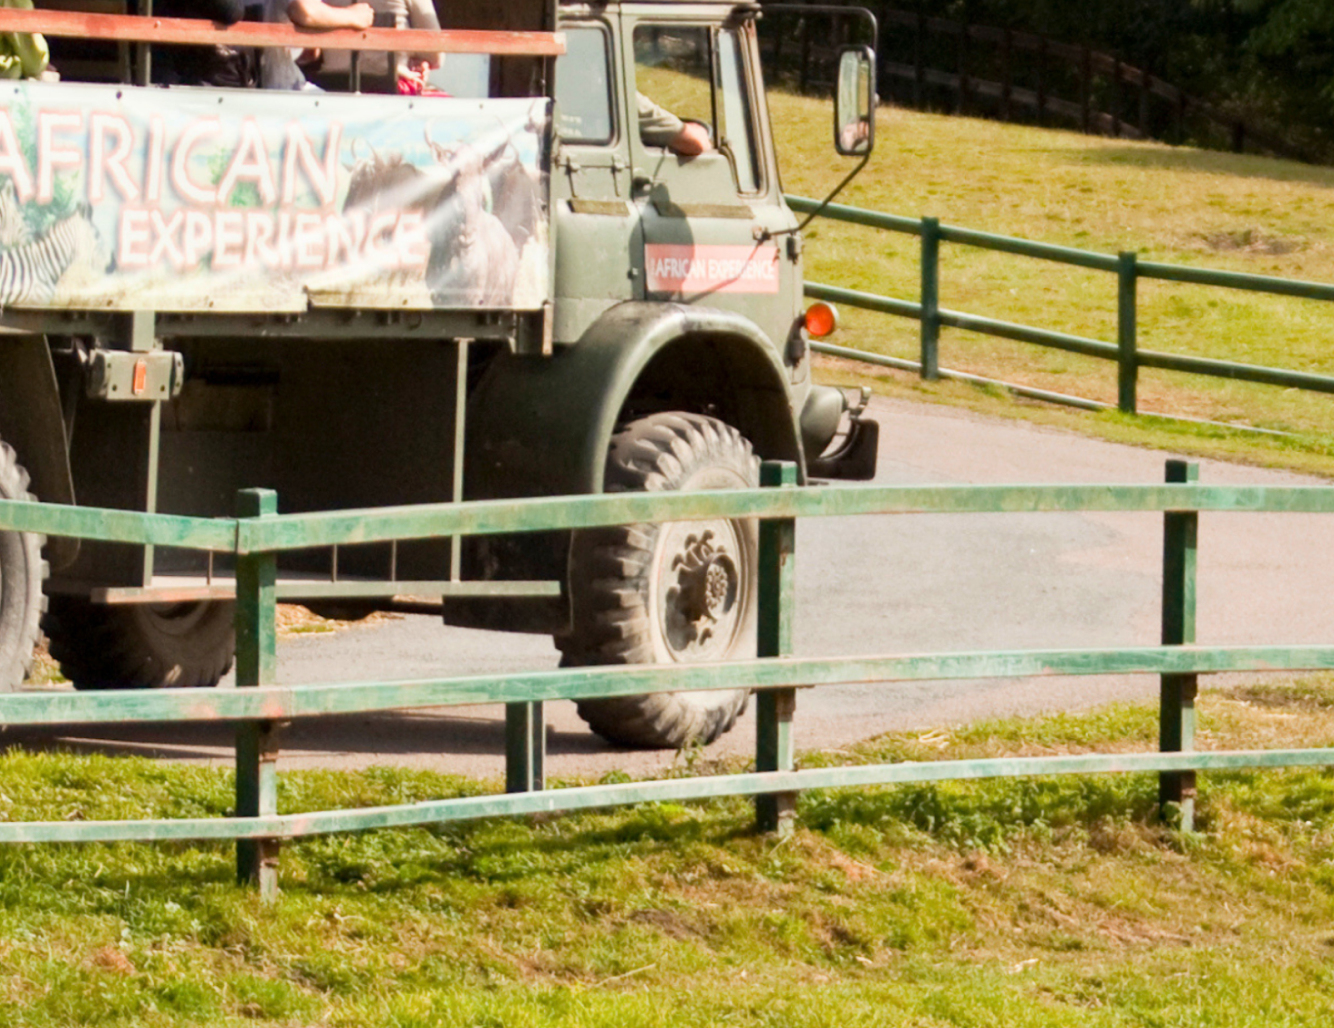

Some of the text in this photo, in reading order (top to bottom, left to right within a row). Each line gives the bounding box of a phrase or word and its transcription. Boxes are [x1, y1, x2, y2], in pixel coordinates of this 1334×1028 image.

[119, 207, 427, 268] EXPERIENCE
[655, 257, 707, 279] AFRICAN
[708, 258, 775, 281] EXPERIENCE
